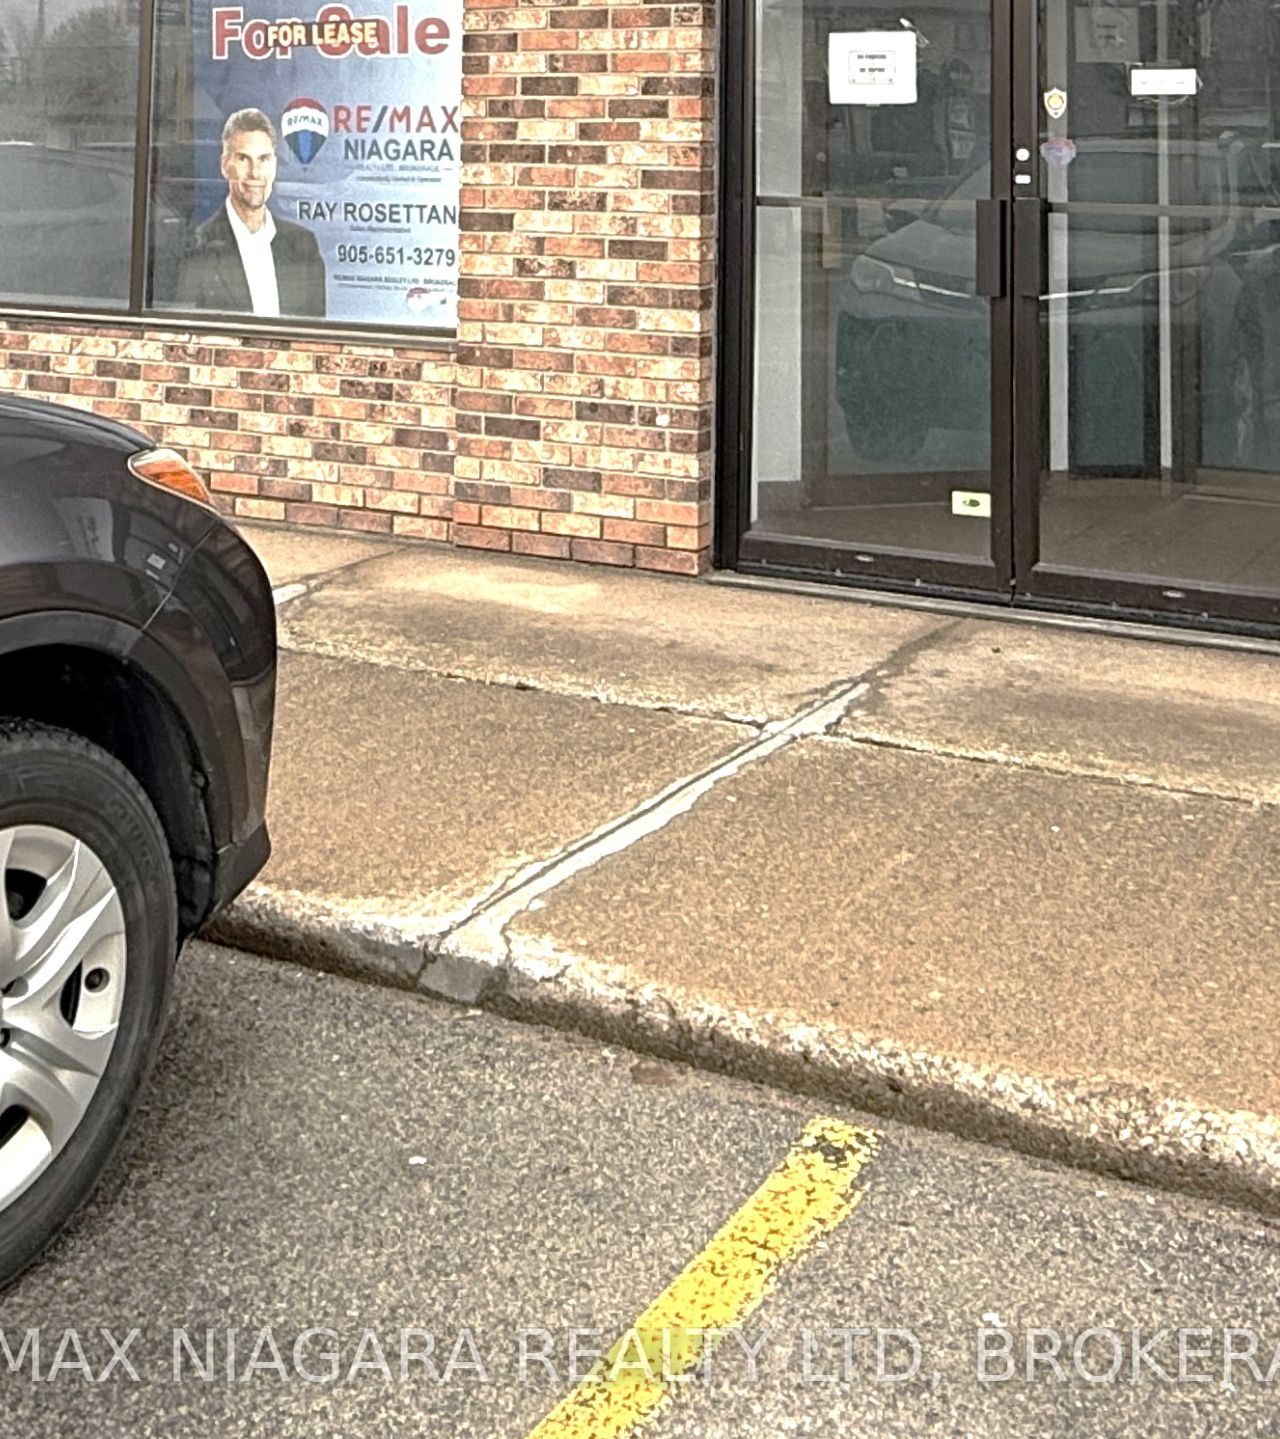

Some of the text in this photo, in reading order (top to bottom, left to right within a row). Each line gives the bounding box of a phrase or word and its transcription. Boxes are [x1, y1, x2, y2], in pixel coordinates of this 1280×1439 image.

[267, 22, 378, 46] FOR LEASE
[287, 115, 323, 127] RE/MAX
[333, 105, 459, 134] RE/MAX
[344, 138, 454, 161] NIAGARA
[298, 201, 457, 224] RAY ROSETTAN
[337, 244, 456, 267] 905-651-3279
